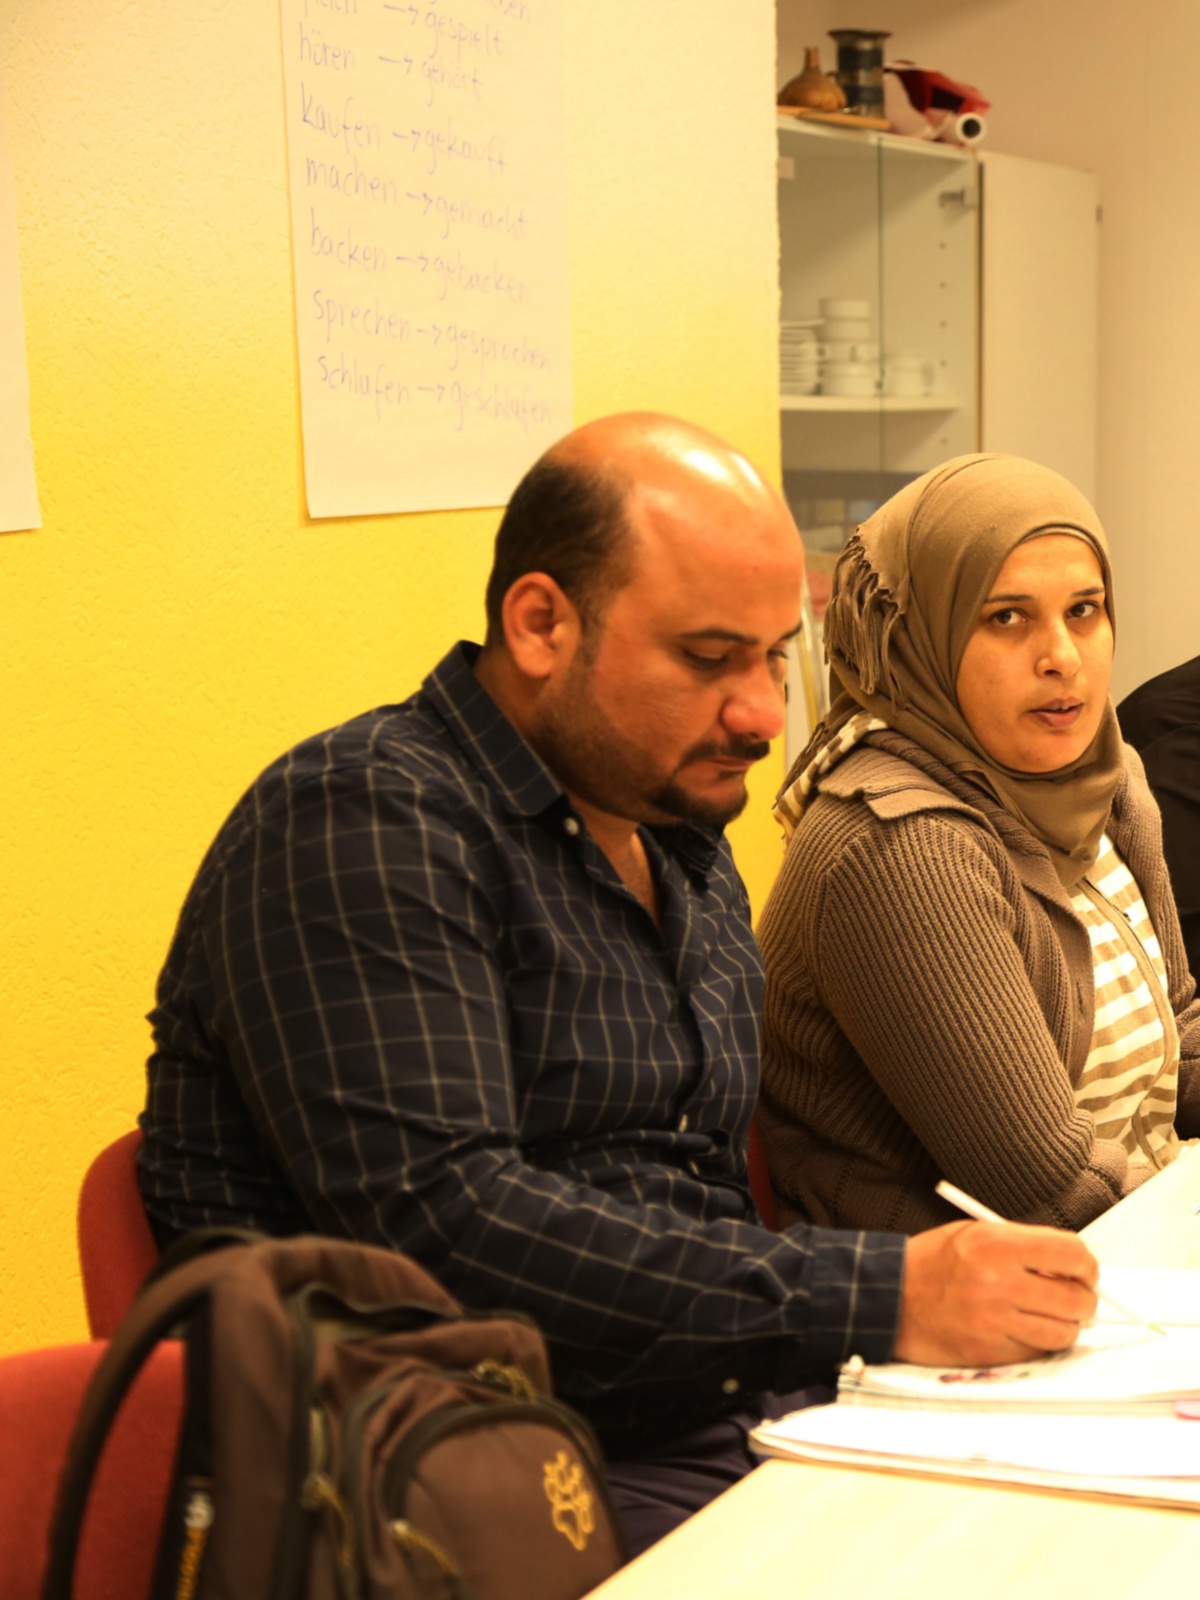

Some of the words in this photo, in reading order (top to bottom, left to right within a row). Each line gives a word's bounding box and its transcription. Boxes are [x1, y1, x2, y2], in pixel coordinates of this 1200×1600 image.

[299, 21, 355, 71] hören
[424, 11, 503, 62] gespielt
[301, 81, 381, 154] kaufen
[425, 117, 506, 177] gekauft
[306, 156, 397, 204] machen
[435, 195, 528, 241] gemacht
[310, 206, 386, 272] backen
[433, 252, 529, 304] gebacken
